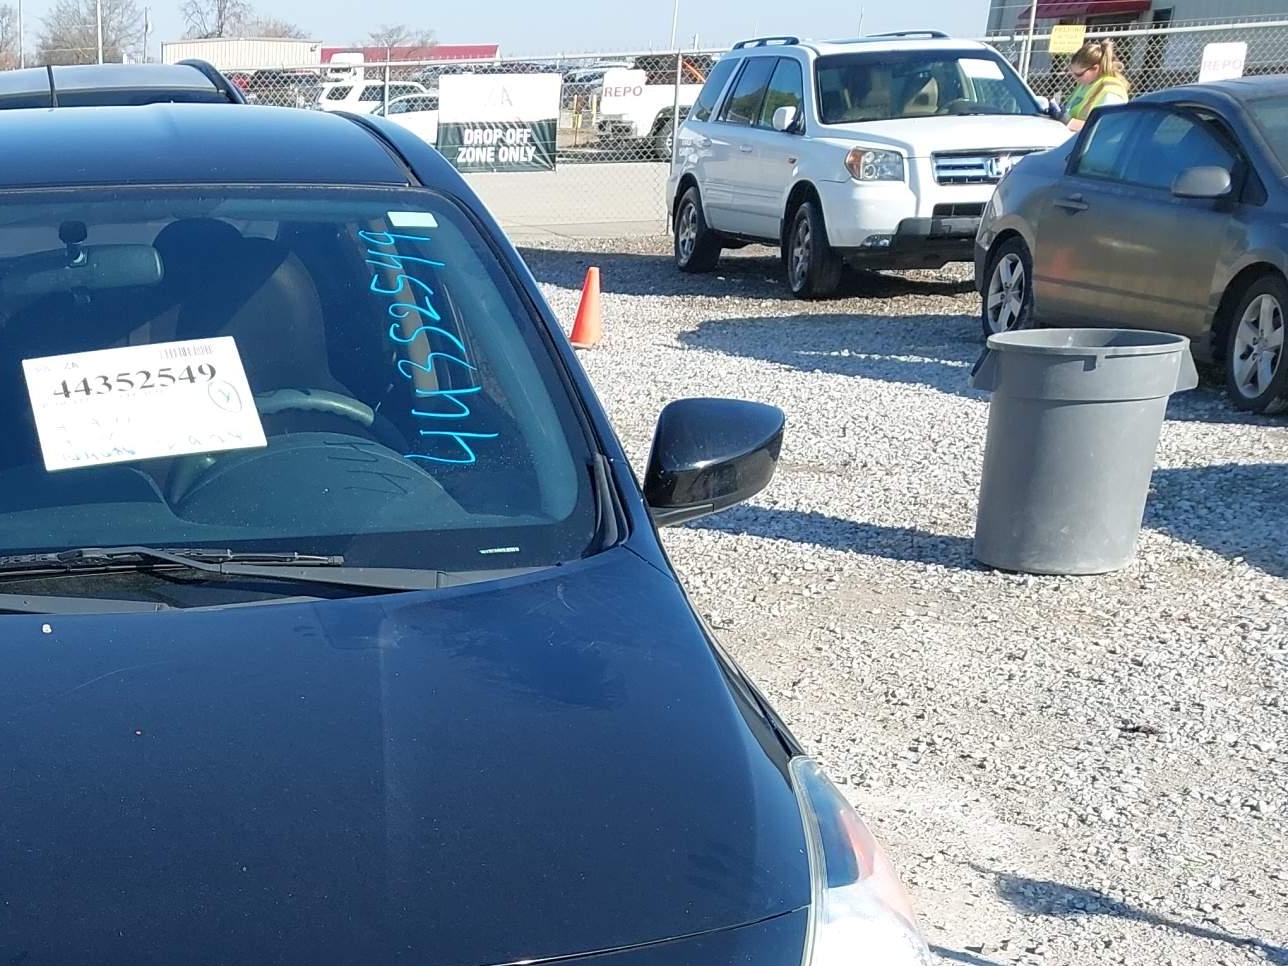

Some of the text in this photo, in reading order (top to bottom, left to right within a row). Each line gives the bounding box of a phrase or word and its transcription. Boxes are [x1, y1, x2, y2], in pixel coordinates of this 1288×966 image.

[603, 85, 643, 98] REPO
[464, 127, 532, 145] DROP OFF
[456, 145, 537, 163] ZONE ONLY
[358, 230, 500, 464] 44352549
[52, 361, 218, 399] 44352549
